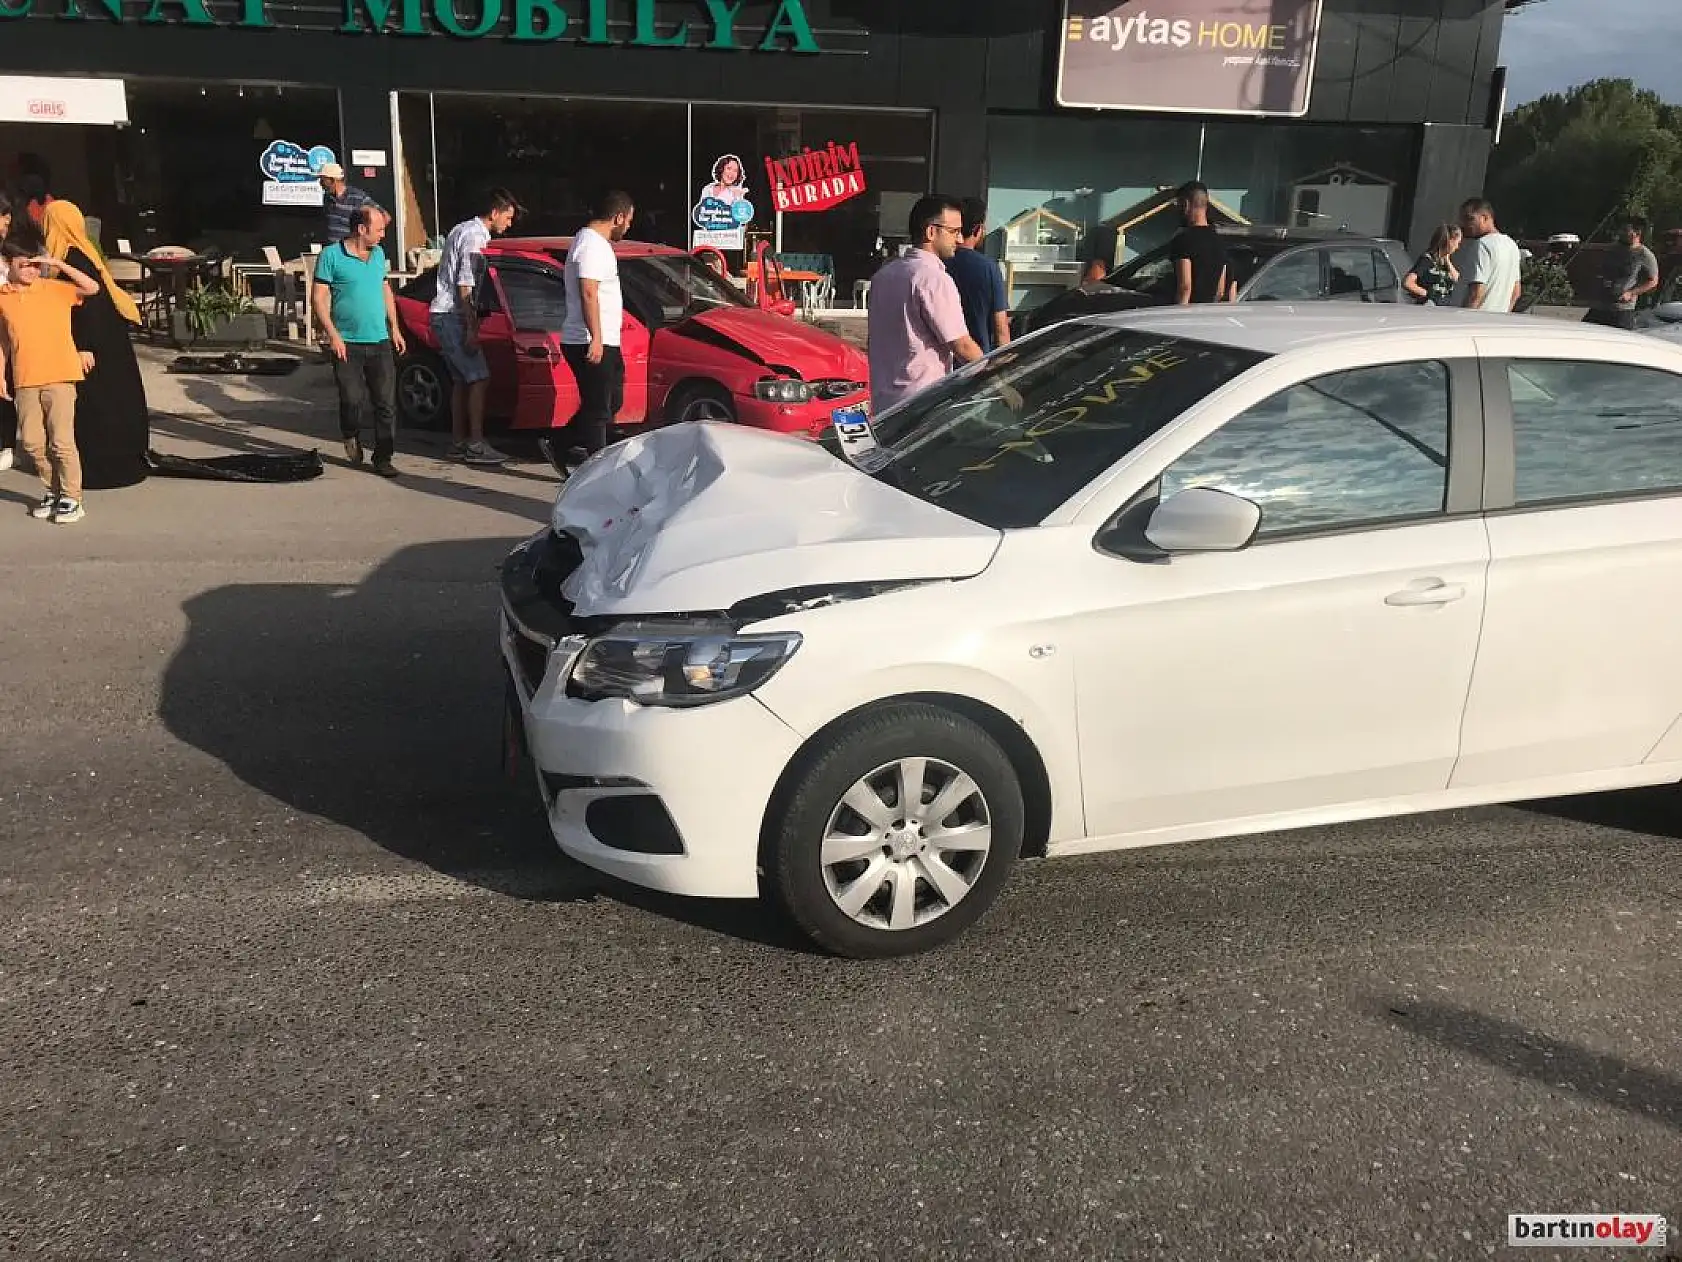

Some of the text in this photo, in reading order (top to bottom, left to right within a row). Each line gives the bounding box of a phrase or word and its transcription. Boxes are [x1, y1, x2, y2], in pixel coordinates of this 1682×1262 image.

[1089, 11, 1288, 50] aytaş HOME
[777, 174, 860, 209] BURADA
